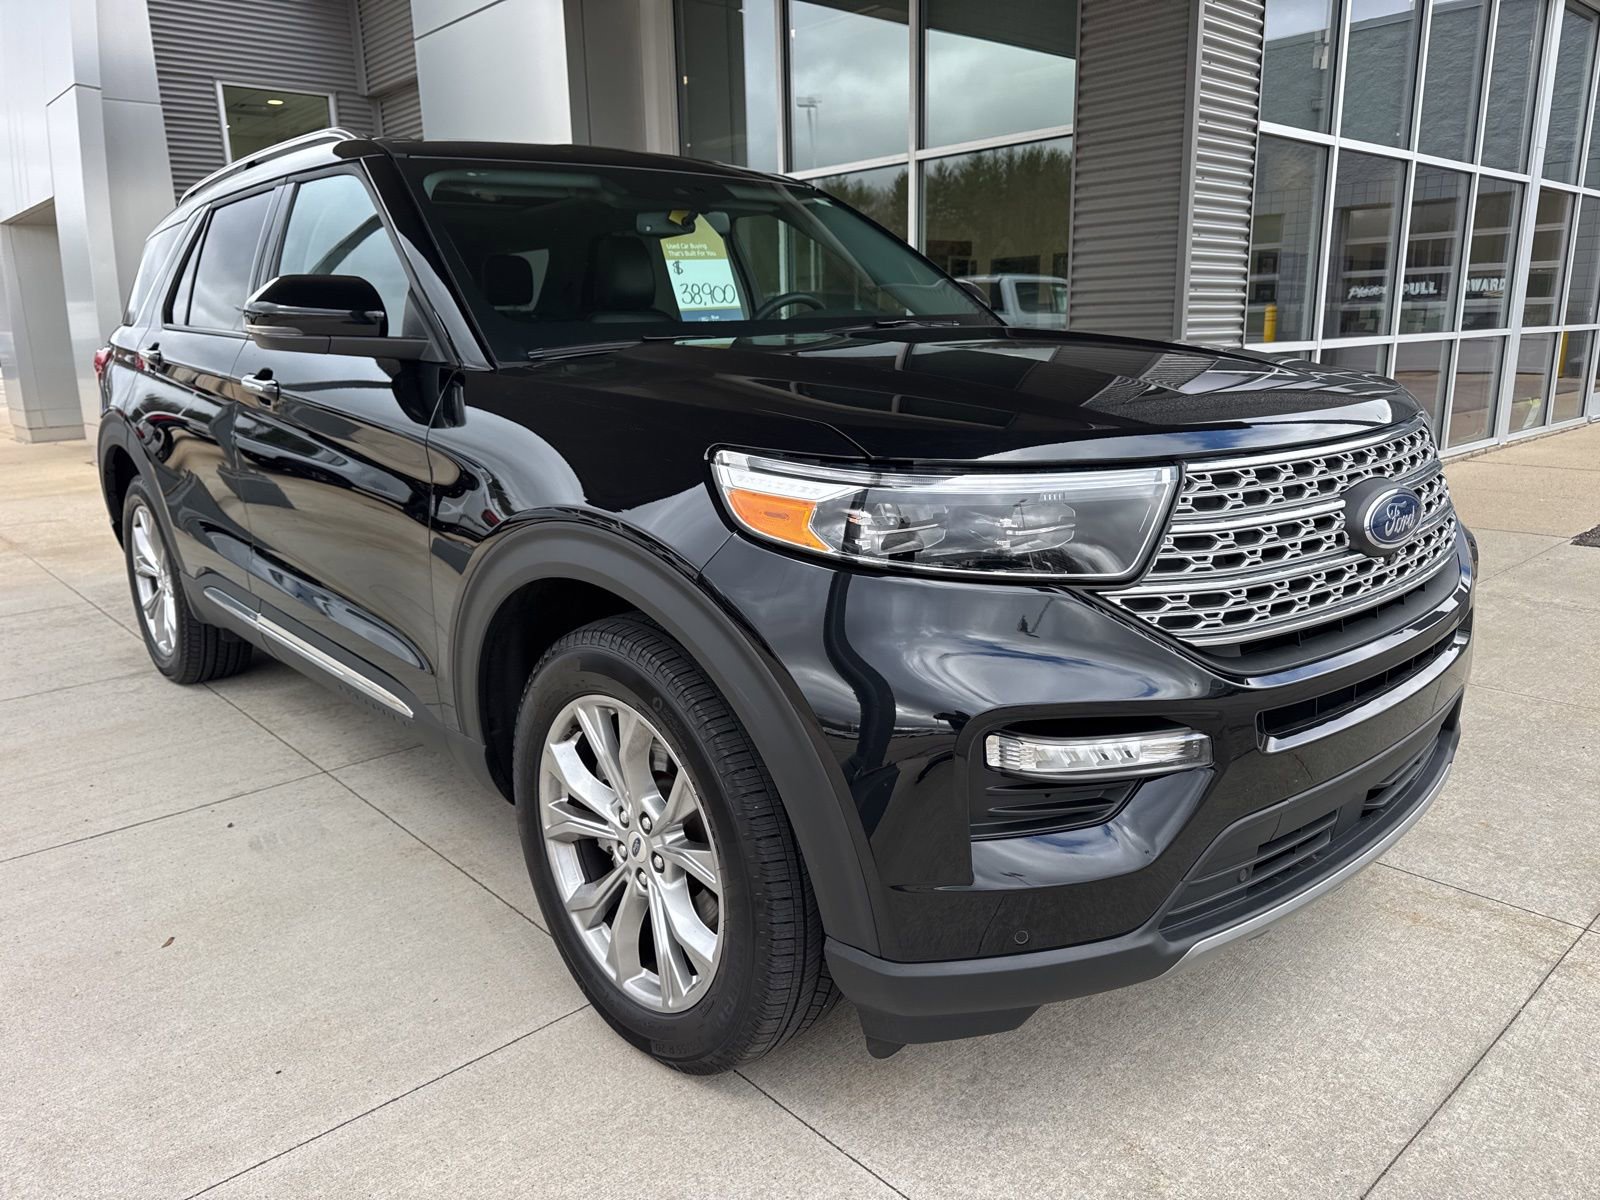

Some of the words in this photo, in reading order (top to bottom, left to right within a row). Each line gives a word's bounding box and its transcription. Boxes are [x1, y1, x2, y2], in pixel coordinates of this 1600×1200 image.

[690, 243, 708, 251] Buying
[672, 260, 684, 275] $
[679, 282, 736, 306] 38,900
[1385, 500, 1415, 536] Ford
